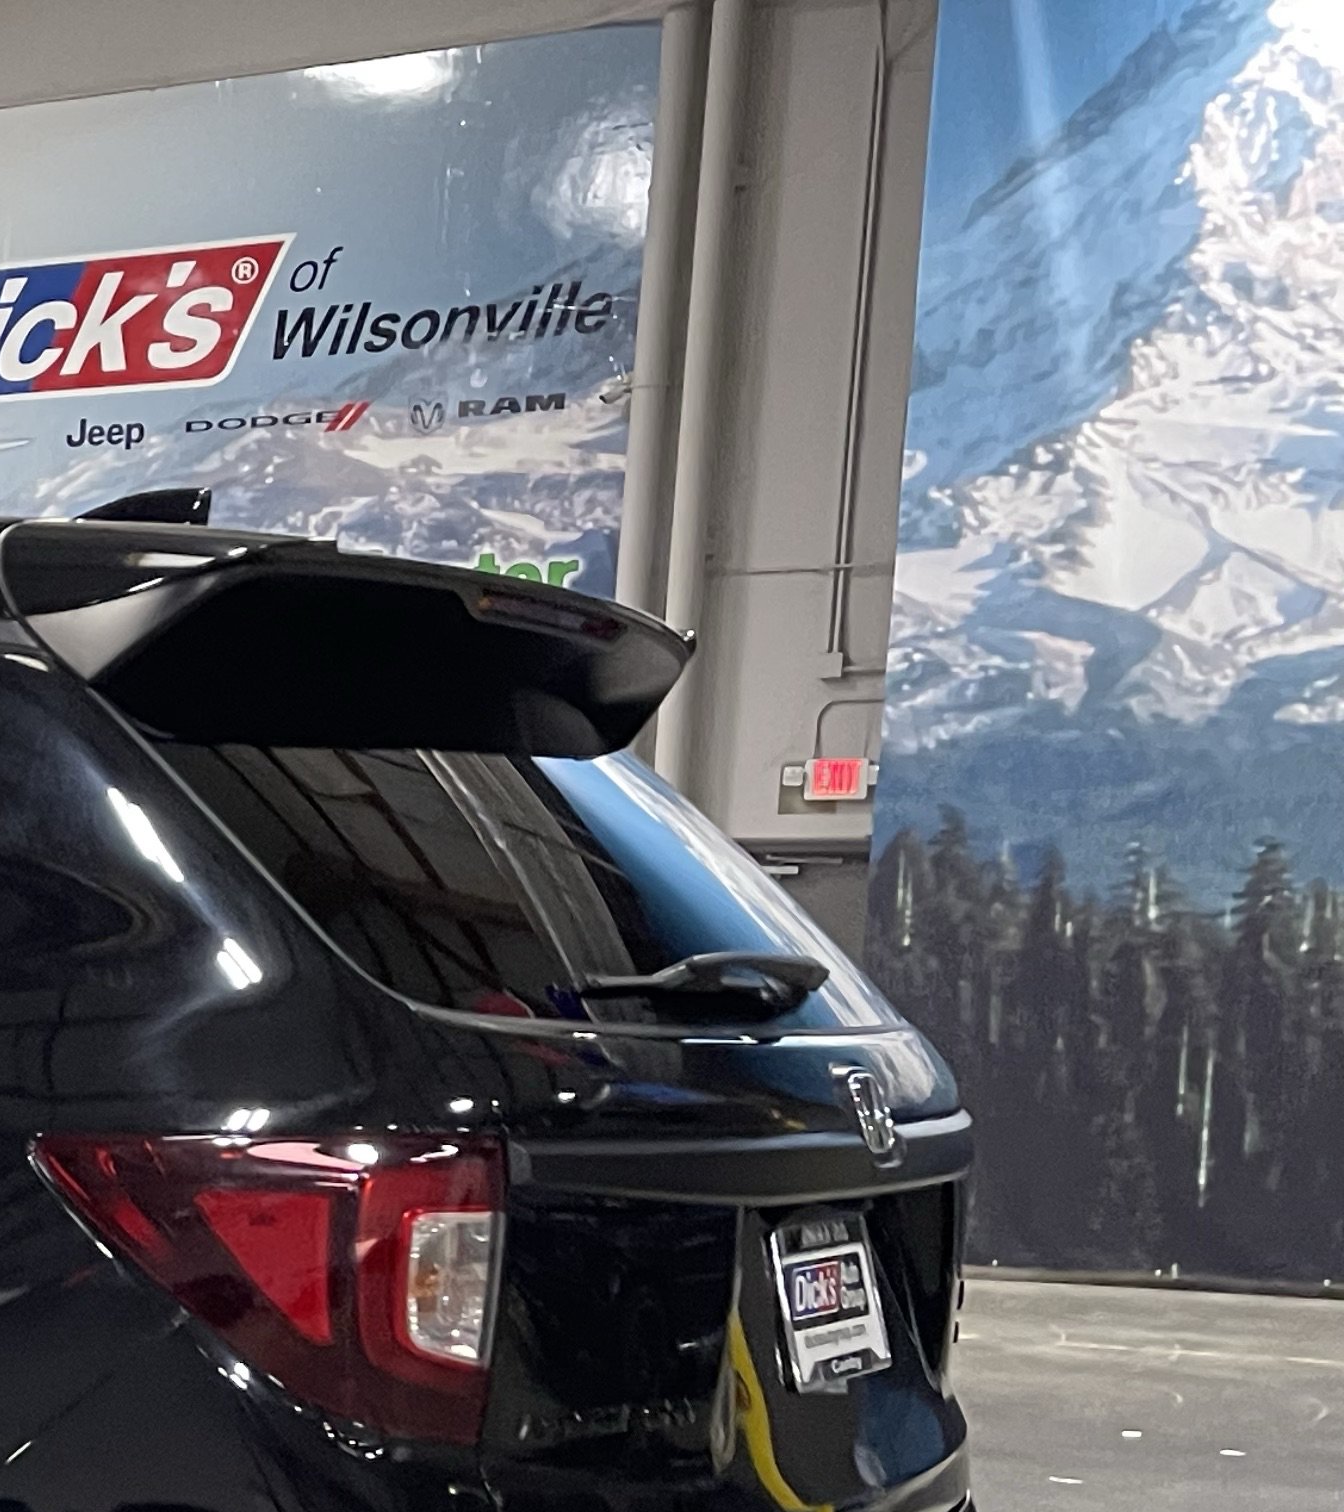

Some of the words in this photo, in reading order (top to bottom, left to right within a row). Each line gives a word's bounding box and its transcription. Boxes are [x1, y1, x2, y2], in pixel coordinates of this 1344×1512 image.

[288, 246, 343, 293] of
[272, 280, 613, 360] Wilsonville
[66, 418, 145, 450] Jeep
[185, 410, 341, 435] DODGE
[457, 393, 567, 418] RAM
